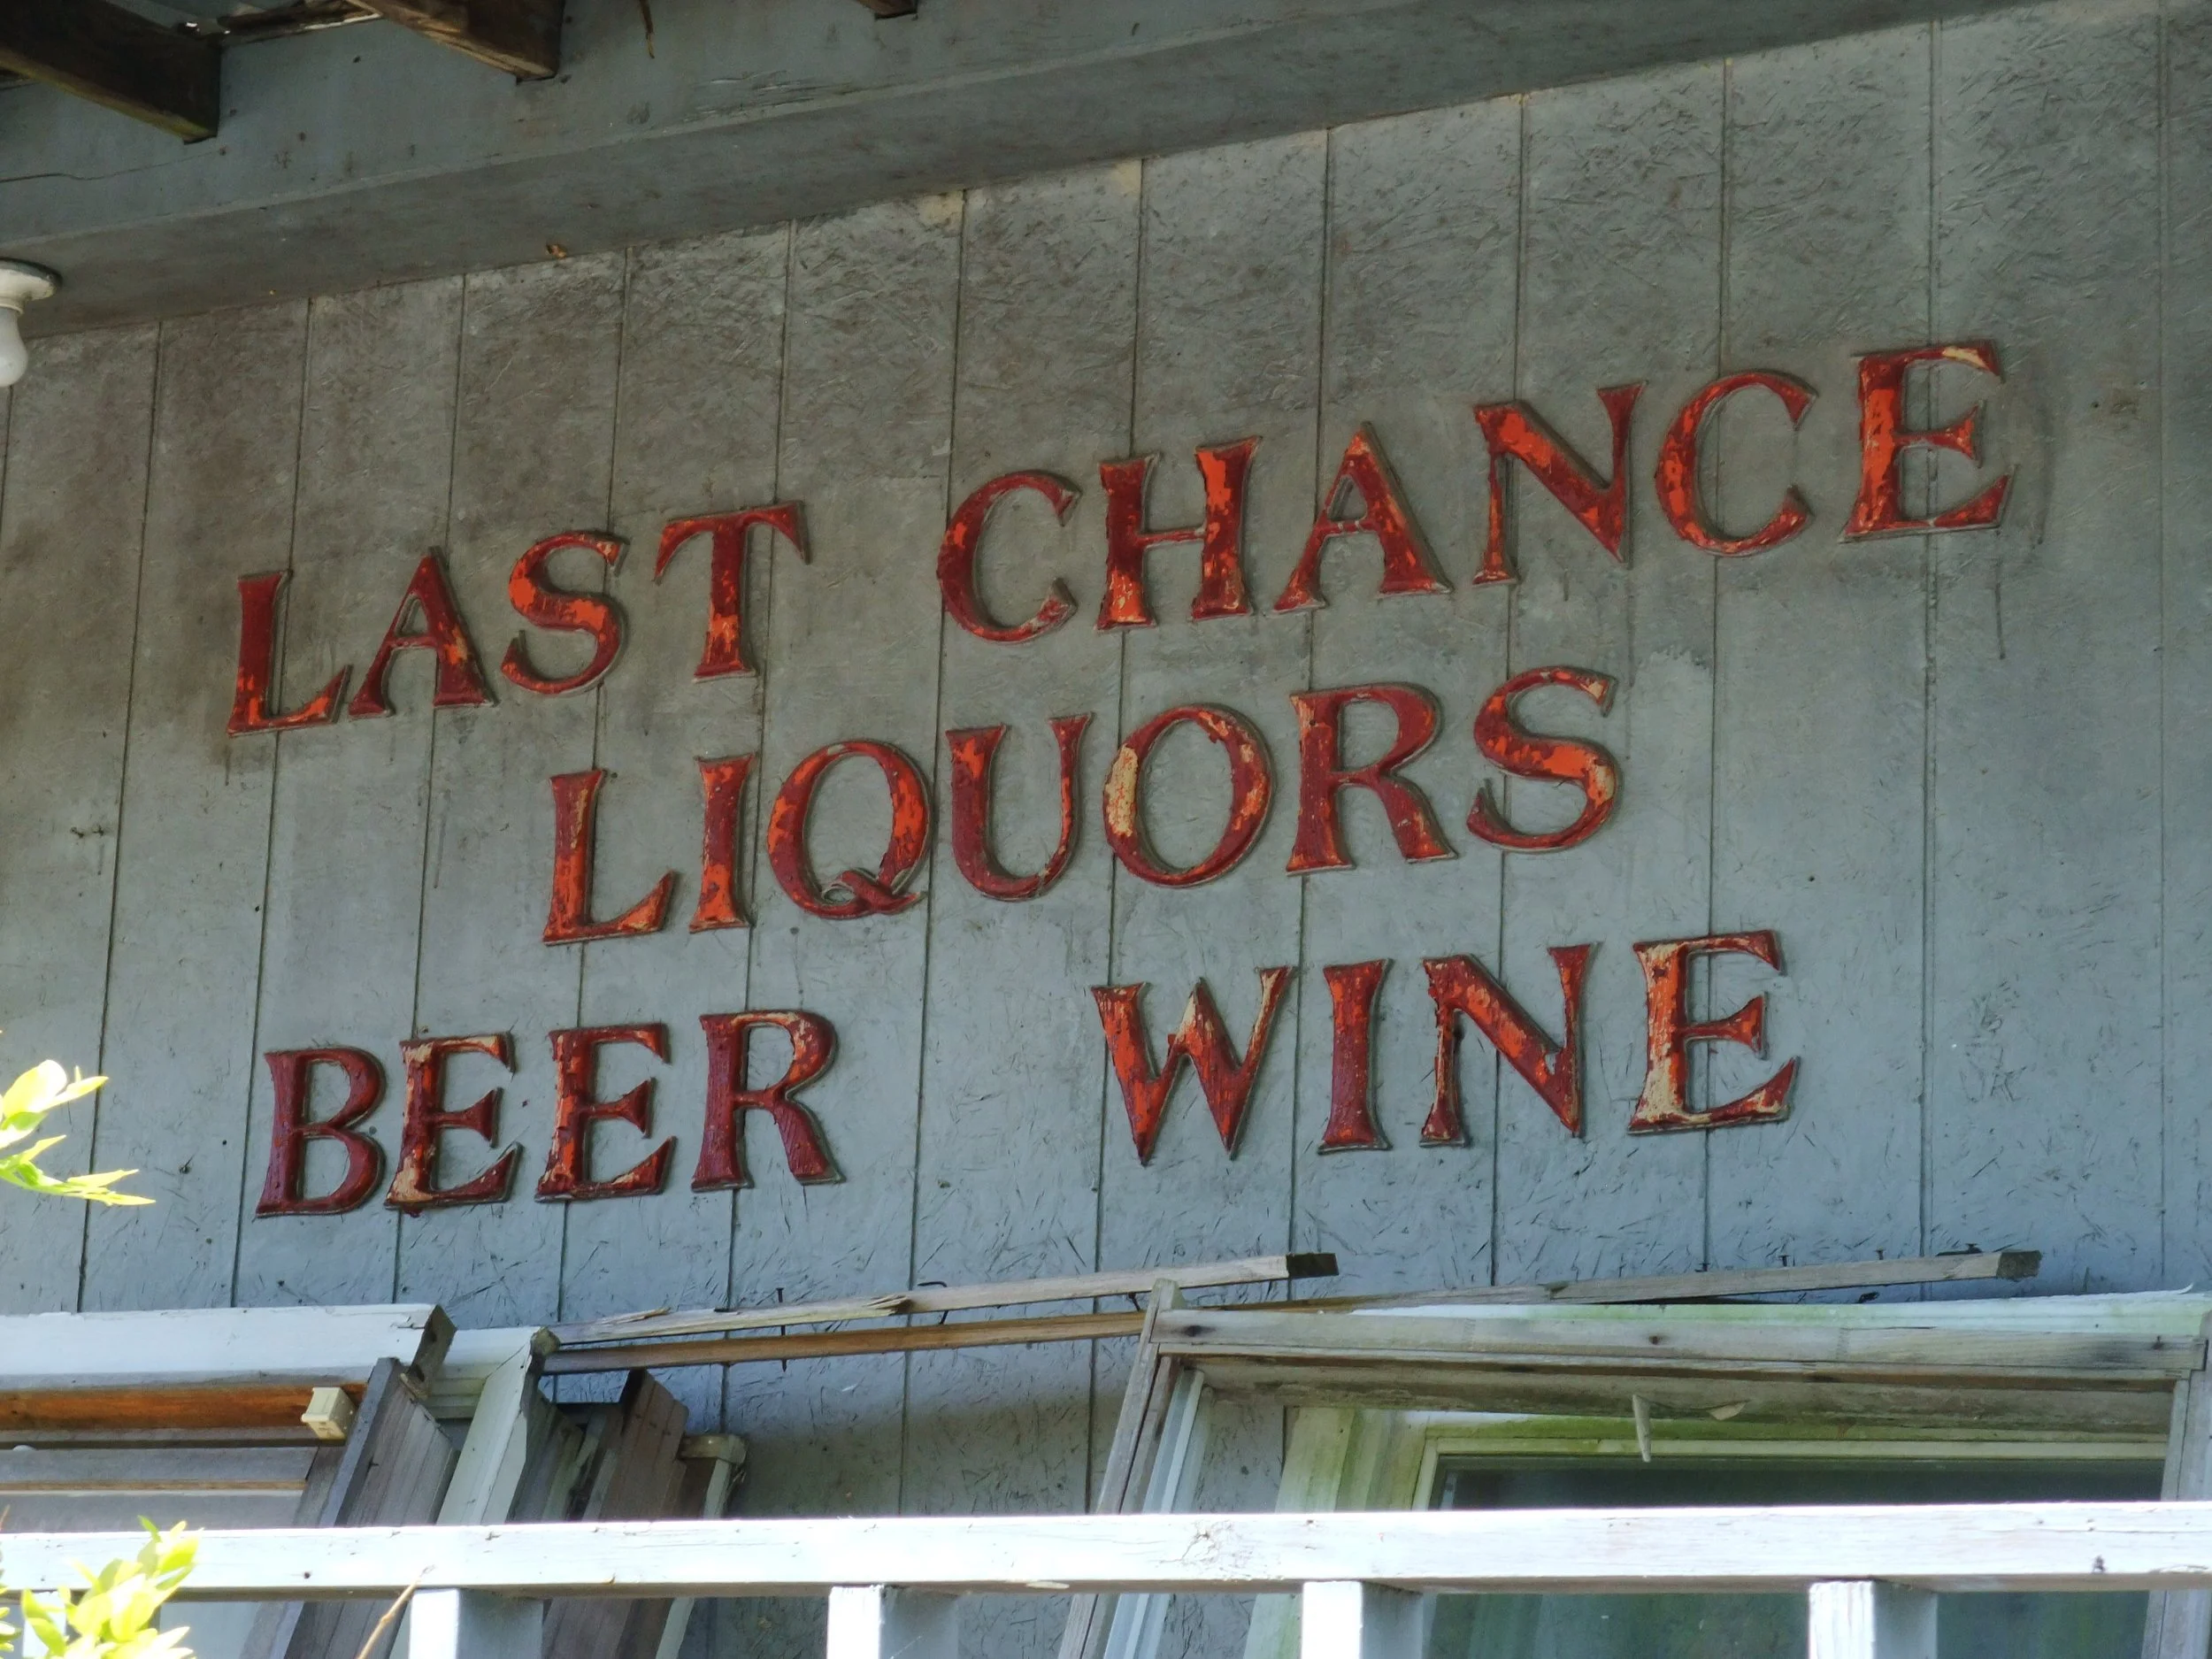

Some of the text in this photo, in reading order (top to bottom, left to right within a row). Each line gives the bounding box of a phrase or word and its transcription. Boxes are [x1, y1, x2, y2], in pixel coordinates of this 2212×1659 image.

[227, 345, 2009, 733] LAST CHANCE
[542, 665, 1622, 945] LIQUORS
[257, 931, 1799, 1217] BEER WINE
